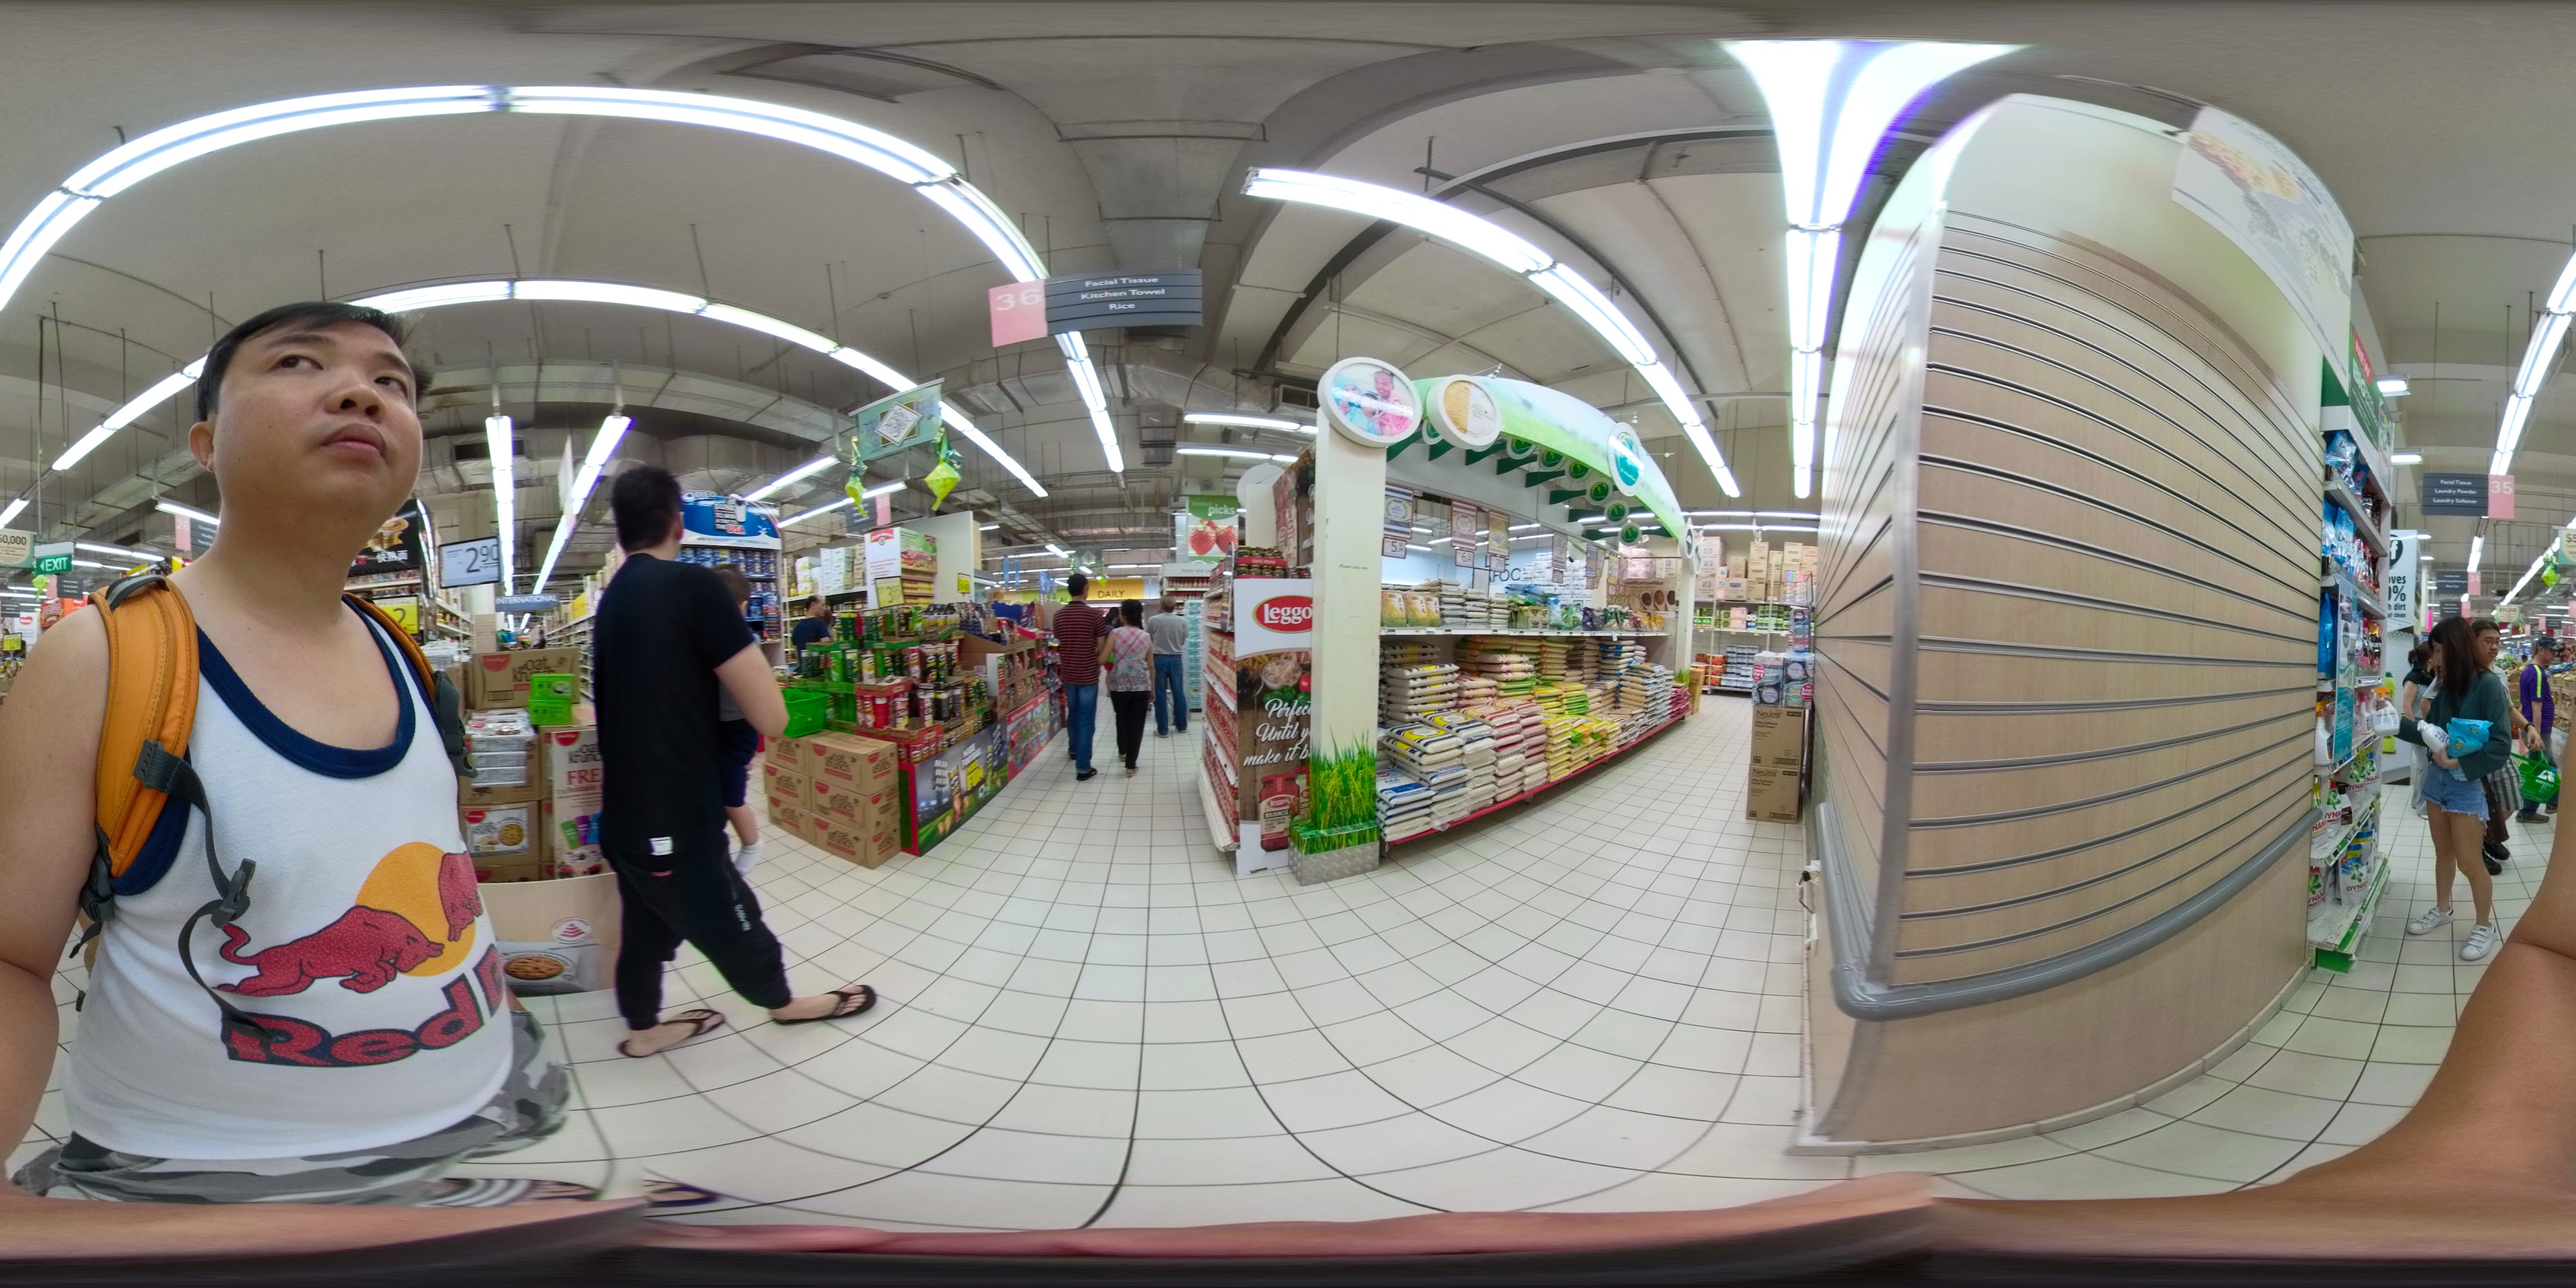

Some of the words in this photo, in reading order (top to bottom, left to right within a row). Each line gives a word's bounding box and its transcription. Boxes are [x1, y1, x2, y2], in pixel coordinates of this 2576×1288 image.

[1085, 278, 1117, 287] Facial
[1122, 277, 1159, 285] Tissue
[996, 289, 1043, 311] 36
[1081, 290, 1126, 299] Kitchen
[2491, 481, 2512, 494] 35
[1208, 504, 1235, 515] picks
[726, 525, 745, 535] USA
[45, 557, 68, 571] EXIT
[466, 547, 480, 573] 2
[480, 544, 498, 562] 90
[495, 594, 558, 604] INTERNATIONAL
[1098, 589, 1124, 598] DAILY
[1255, 721, 1299, 742] Until
[1244, 748, 1282, 766] make
[1285, 744, 1301, 761] it
[221, 973, 484, 1068] Red
